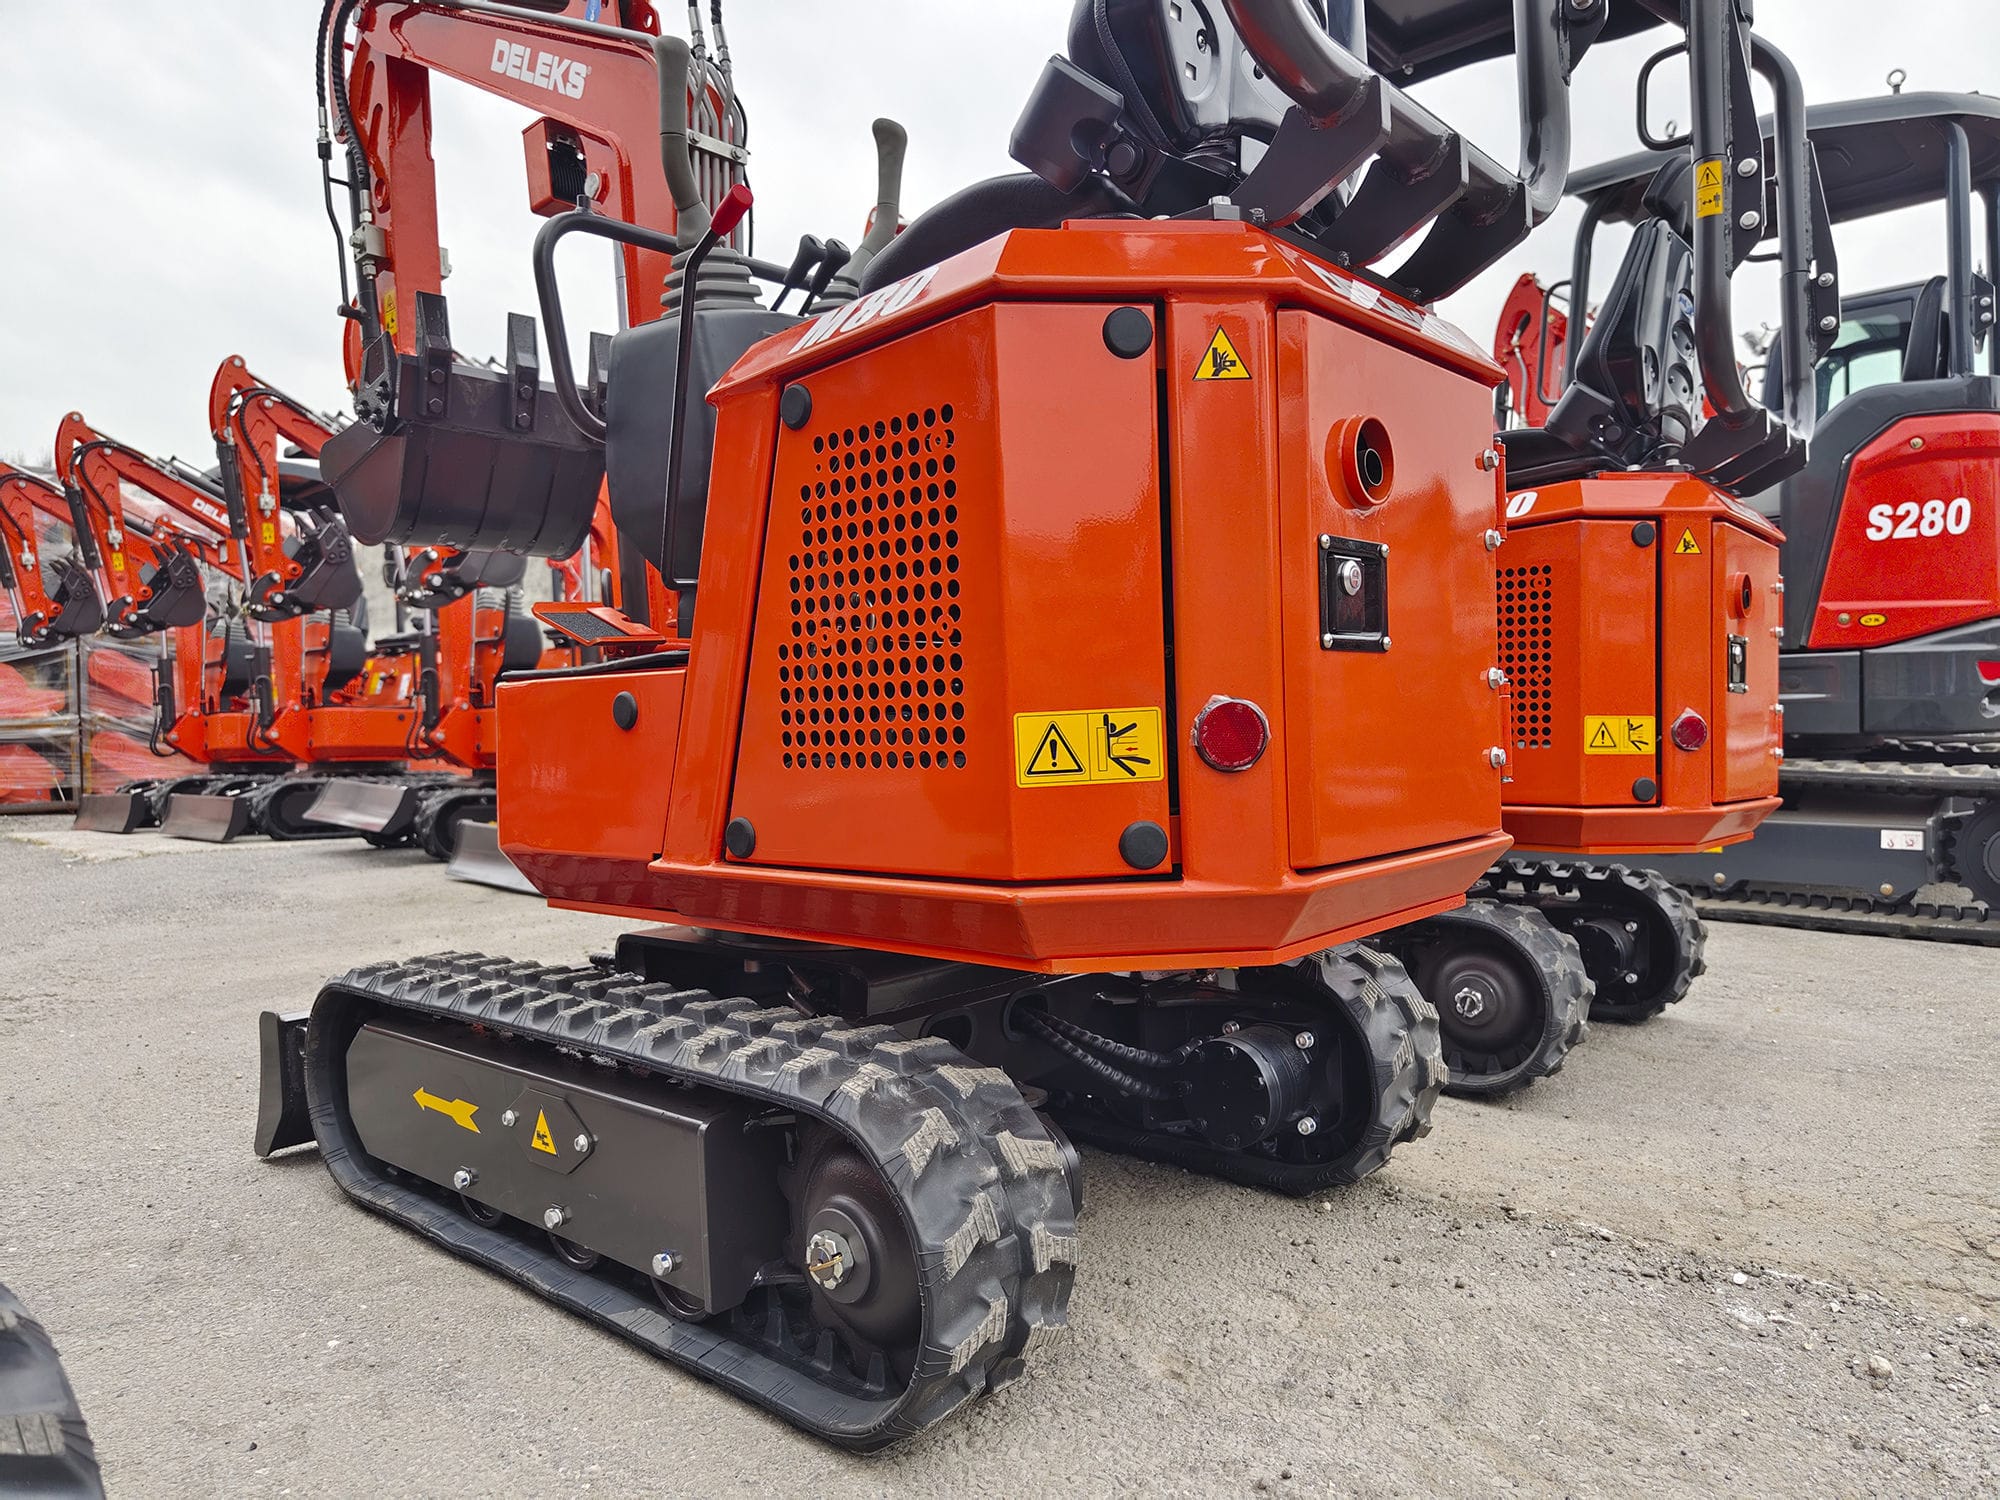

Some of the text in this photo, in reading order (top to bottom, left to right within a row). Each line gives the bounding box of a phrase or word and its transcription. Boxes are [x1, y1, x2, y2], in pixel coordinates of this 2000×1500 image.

[490, 38, 587, 100] DELEKS
[787, 264, 940, 356] M80
[1865, 497, 1971, 541] S280
